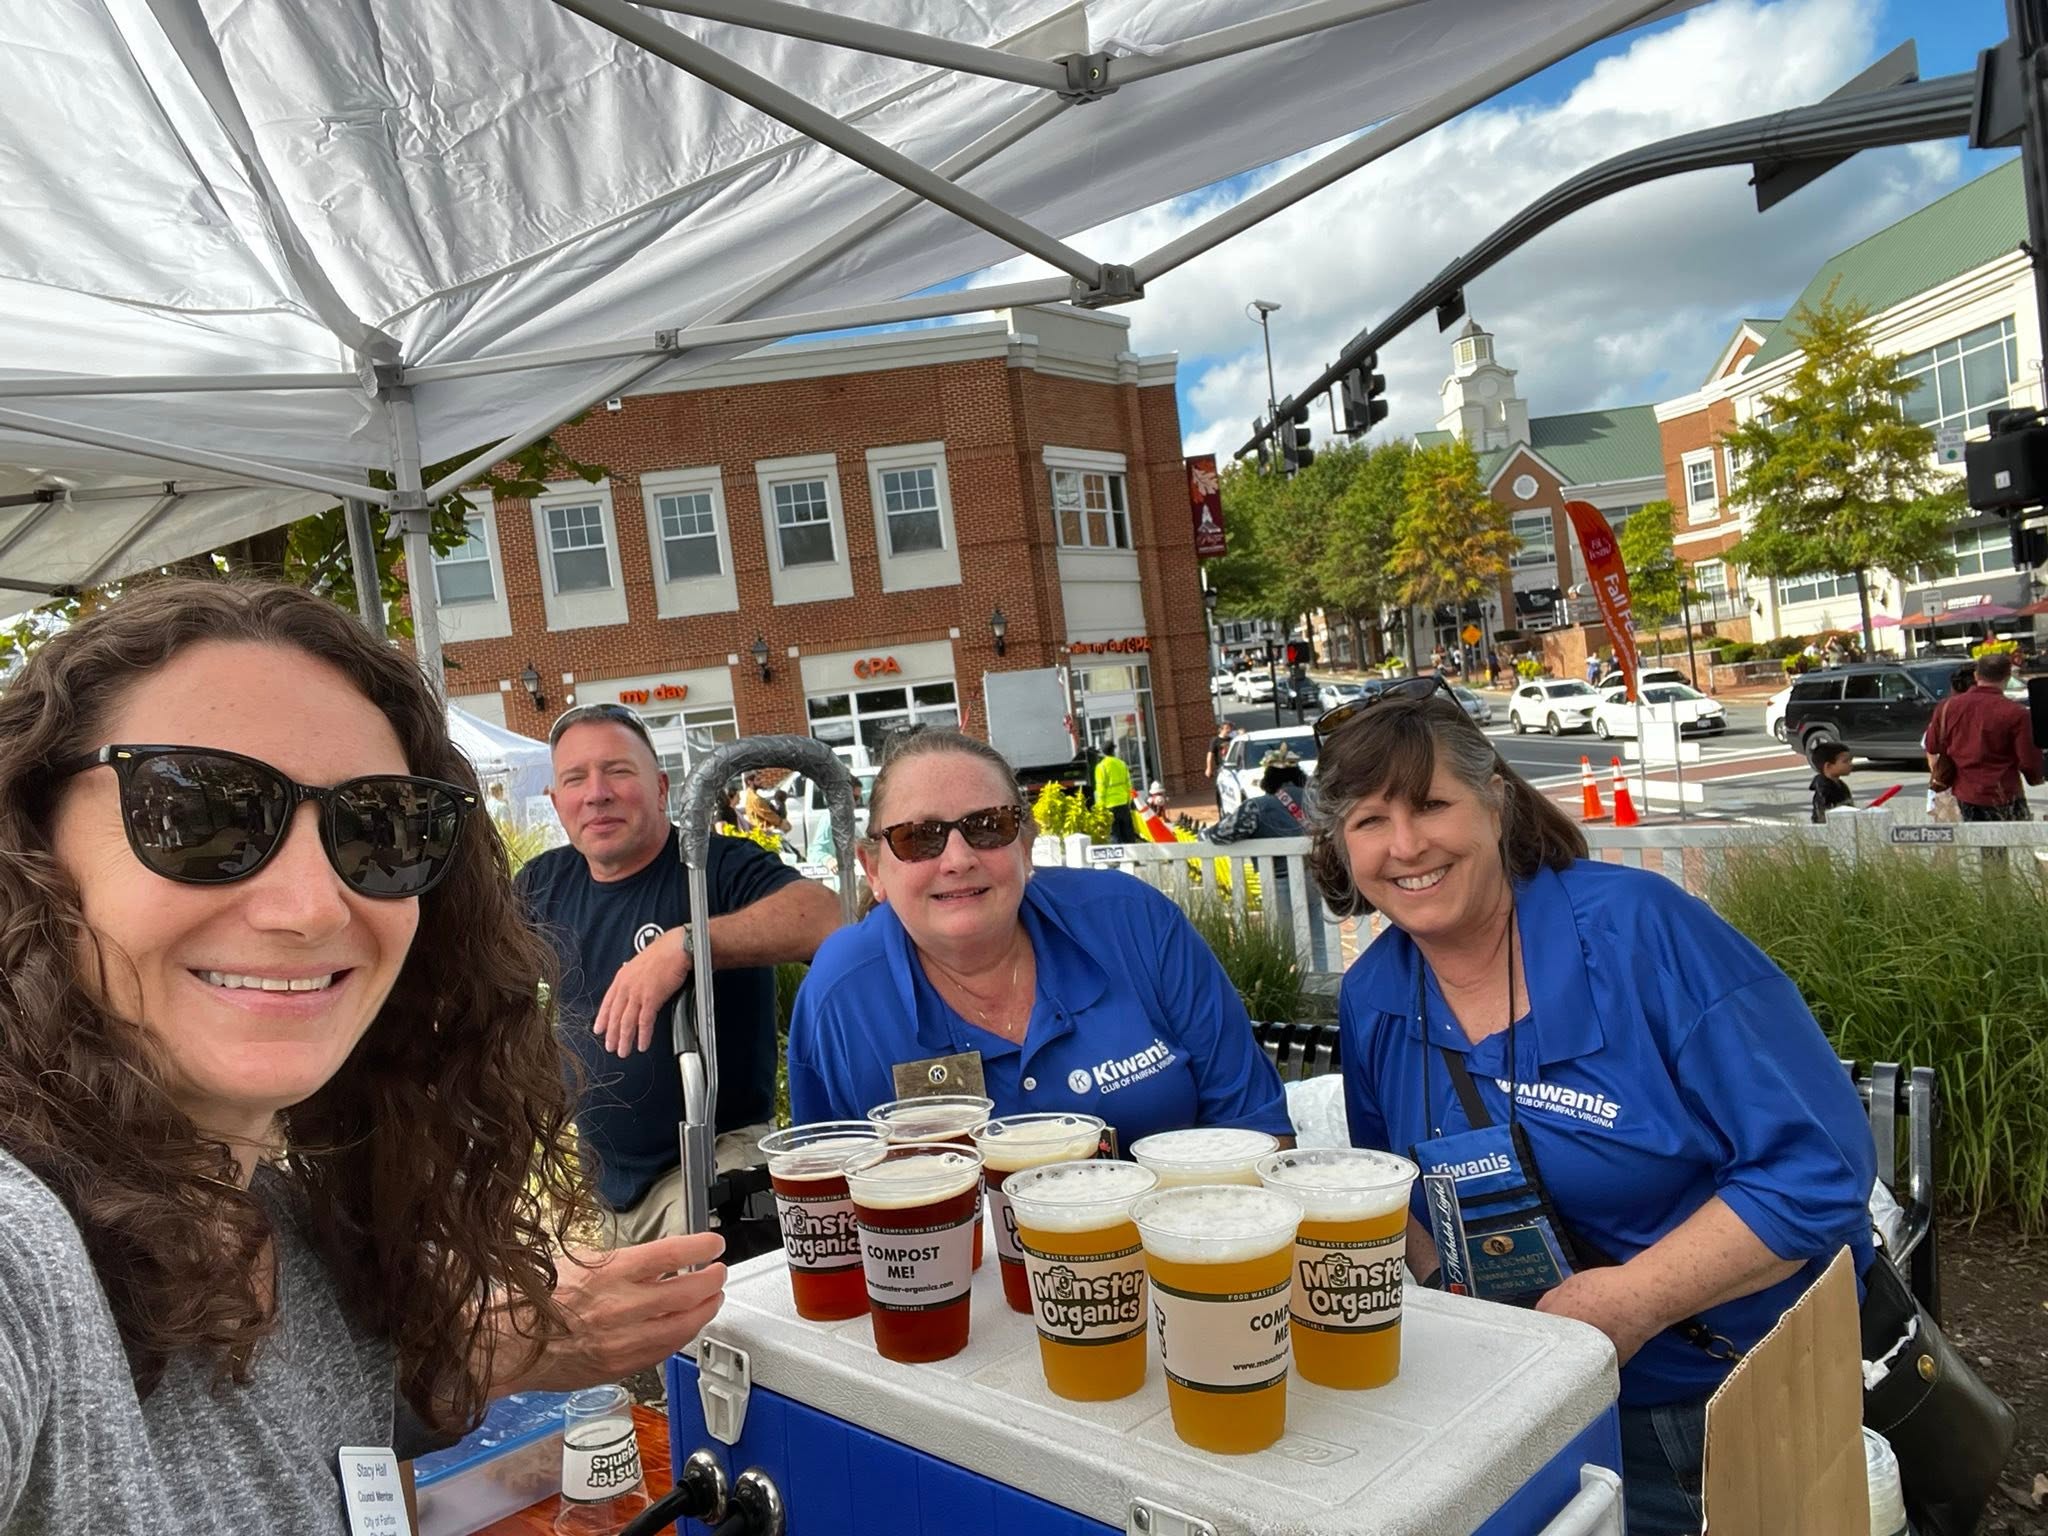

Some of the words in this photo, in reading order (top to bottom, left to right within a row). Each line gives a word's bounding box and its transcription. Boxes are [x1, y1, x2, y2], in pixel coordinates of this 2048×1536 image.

[1604, 572, 1628, 609] Fall
[854, 656, 902, 679] CPA
[619, 689, 649, 704] my
[654, 684, 688, 700] day
[1100, 1081, 1121, 1094] CLUB
[1120, 1076, 1131, 1087] OF
[1515, 1096, 1533, 1106] CLUB
[1533, 1099, 1545, 1109] OF
[1578, 1111, 1614, 1129] VIRGINIA
[1431, 1151, 1511, 1177] Kiwanis
[1434, 1182, 1453, 1222] Light
[780, 1205, 857, 1236] Monste
[926, 1222, 956, 1232] SERVICES
[867, 1245, 940, 1262] COMPOST
[1319, 1240, 1344, 1248] WASTE
[1347, 1238, 1390, 1249] COMPOSTING
[1441, 1217, 1464, 1284] Michelob
[1069, 1253, 1116, 1261] COMPOSTING
[888, 1265, 915, 1279] ME!
[1032, 1265, 1143, 1302] Monster
[1228, 1293, 1249, 1301] FOOD
[1251, 1289, 1274, 1299] WASTE
[1041, 1299, 1139, 1335] Organics
[357, 1463, 374, 1480] Stacy
[375, 1463, 388, 1477] Hall
[358, 1490, 375, 1502] Council
